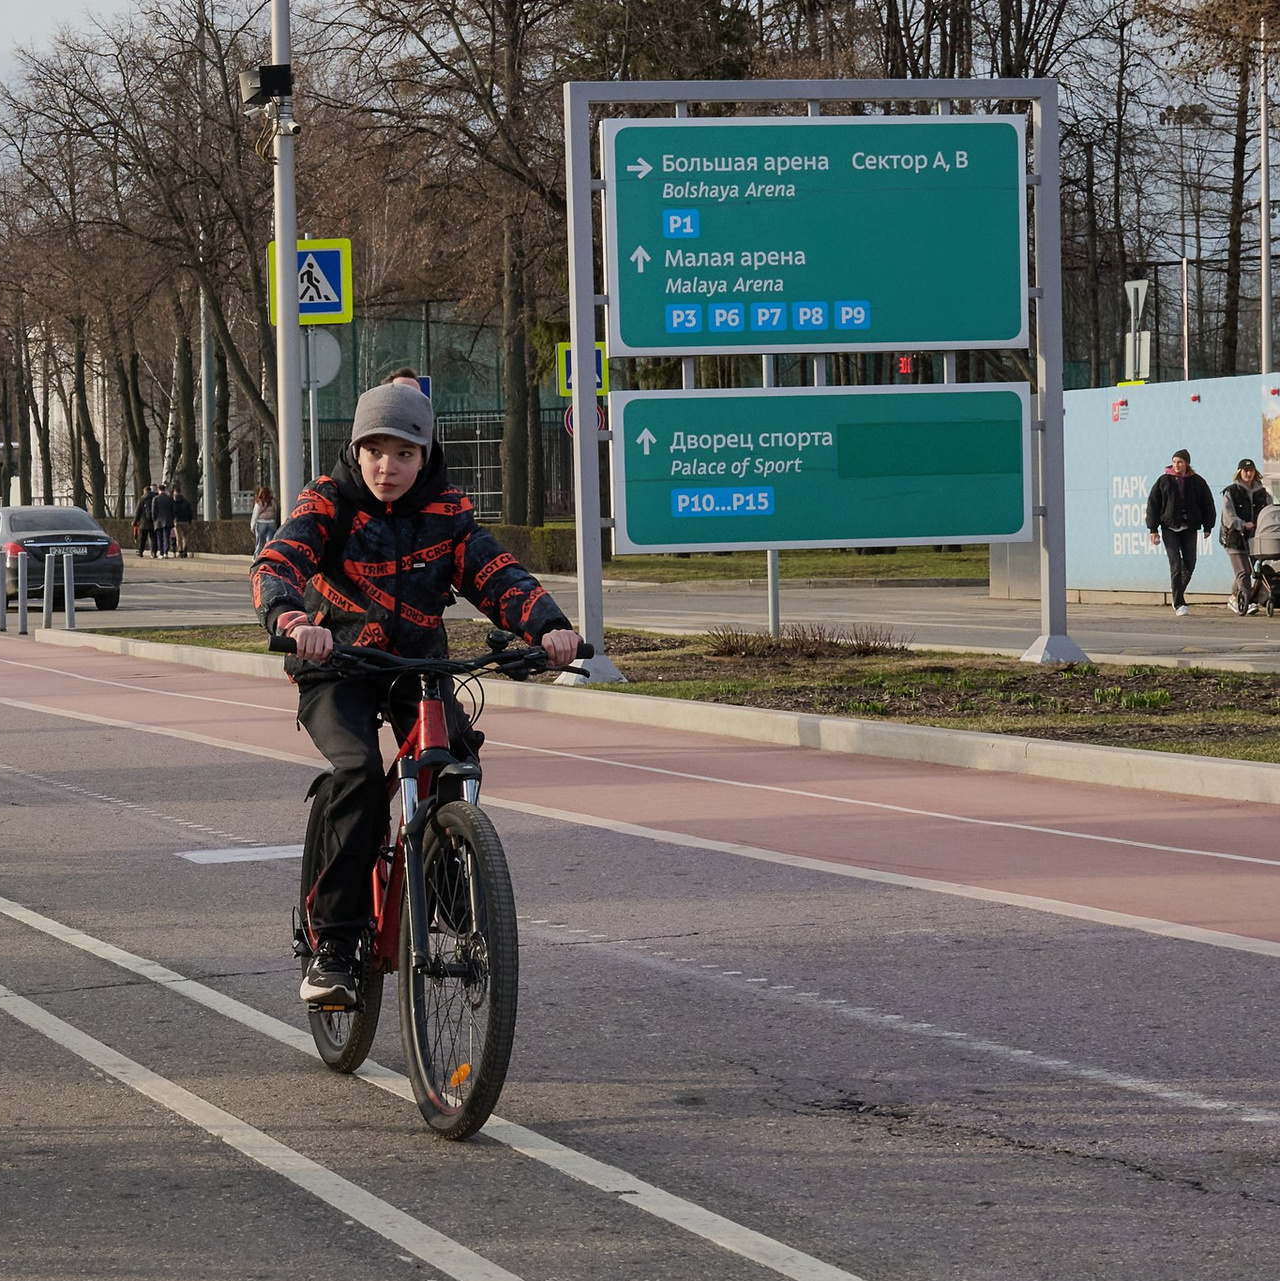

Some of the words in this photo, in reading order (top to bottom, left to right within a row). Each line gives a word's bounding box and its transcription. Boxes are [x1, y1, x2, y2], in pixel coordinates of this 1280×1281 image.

[662, 154, 758, 172] Большая
[763, 155, 829, 175] арена
[851, 151, 928, 174] Сектор
[662, 181, 739, 202] Bolshaya
[744, 181, 796, 197] Arena
[668, 215, 694, 233] P1
[664, 249, 735, 268] Малая
[740, 250, 806, 270] арена
[665, 276, 728, 297] Malaya
[732, 276, 784, 293] Arena
[671, 309, 697, 328] P3
[714, 308, 740, 327] P6
[757, 307, 782, 326] P7
[799, 306, 824, 325] P8
[840, 306, 866, 324] P9
[670, 431, 753, 453] Дворец
[758, 431, 833, 451] спорта
[670, 458, 727, 476] Palace
[731, 457, 751, 478] of
[753, 457, 803, 477] Sport
[1112, 476, 1147, 498] ПАРК
[677, 492, 769, 512] P10...P15
[327, 588, 353, 612] TRMT
